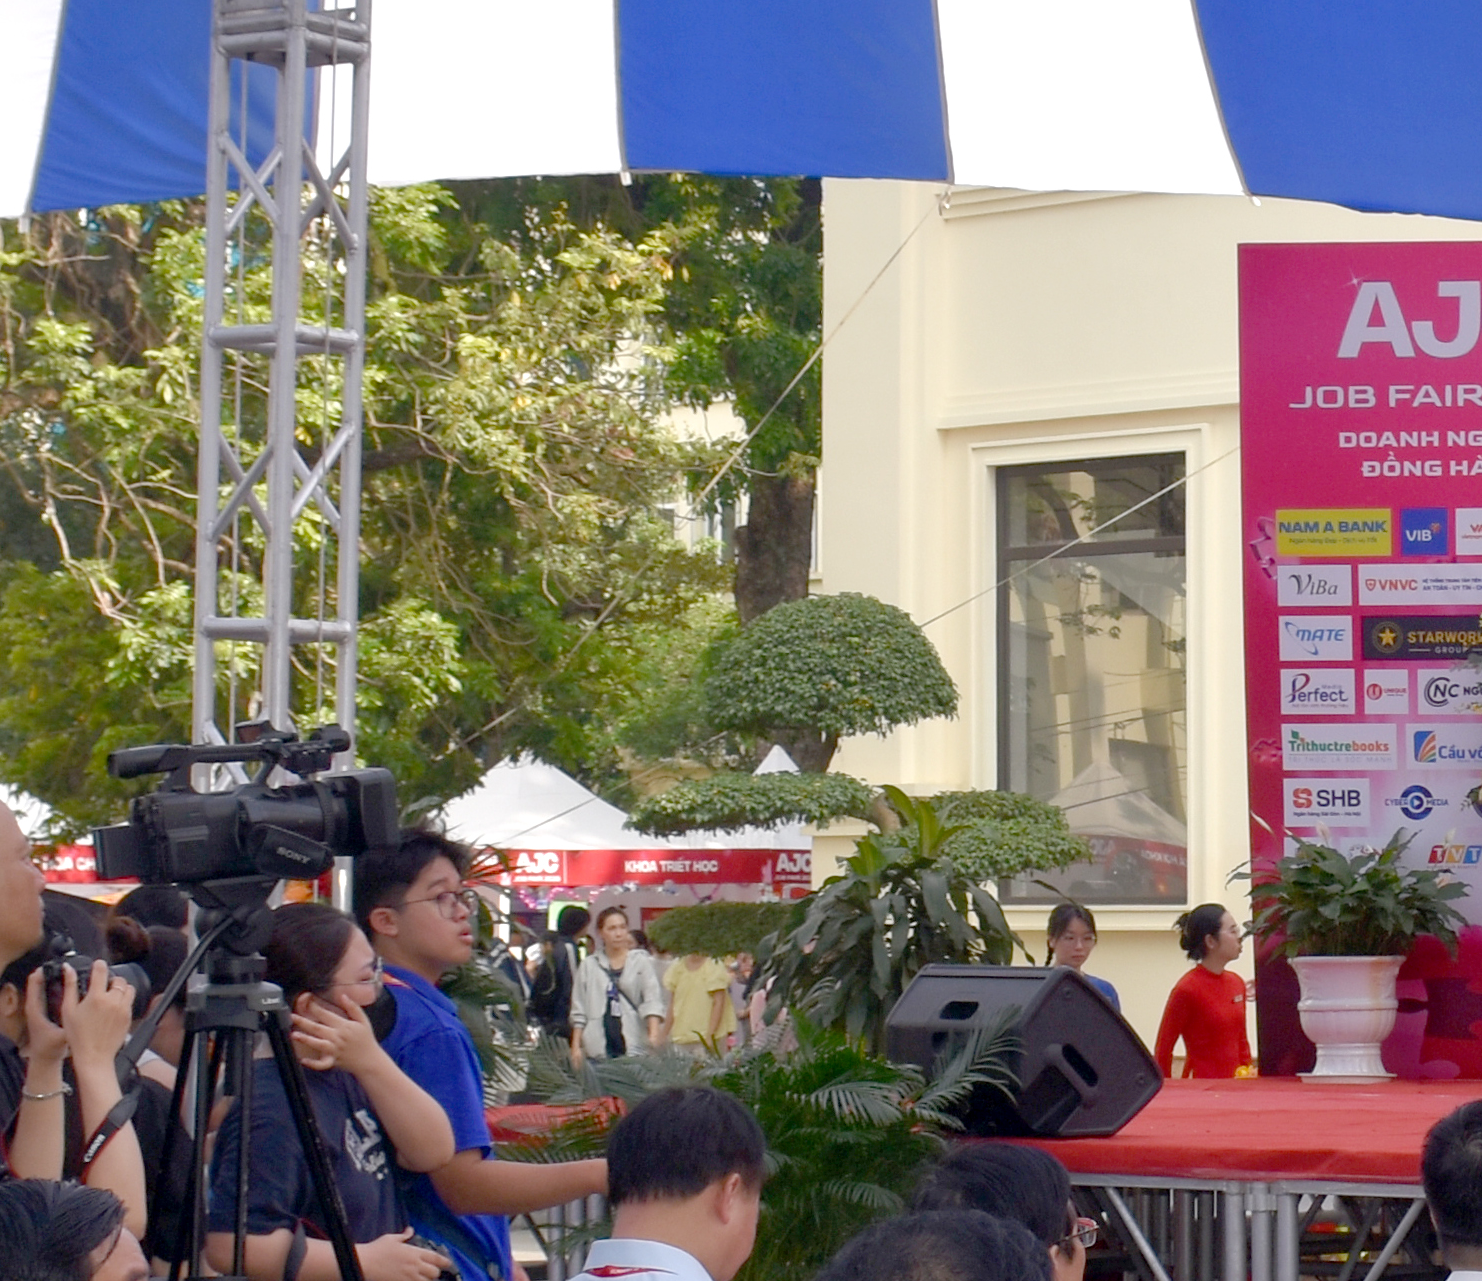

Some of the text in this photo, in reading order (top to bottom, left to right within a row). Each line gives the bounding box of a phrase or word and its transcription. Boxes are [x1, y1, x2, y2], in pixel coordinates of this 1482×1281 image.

[1289, 385, 1376, 409] JOB
[1339, 431, 1439, 448] DOANH
[1361, 451, 1442, 478] ĐỒNG
[1278, 520, 1388, 534] NAM A BANK
[1406, 530, 1432, 541] VIB
[1379, 579, 1418, 591] VNVC
[1434, 645, 1467, 654] GROUP
[1286, 673, 1348, 703] Perfect
[1288, 739, 1389, 752] Trithuctrebooks
[1317, 790, 1361, 807] SHB
[1385, 798, 1449, 806] CYBER MEDIA
[275, 846, 312, 865] SONY
[516, 852, 560, 873] AJC
[1429, 845, 1482, 864] TVT
[624, 856, 718, 874] KHOA TRIẾT HỌC
